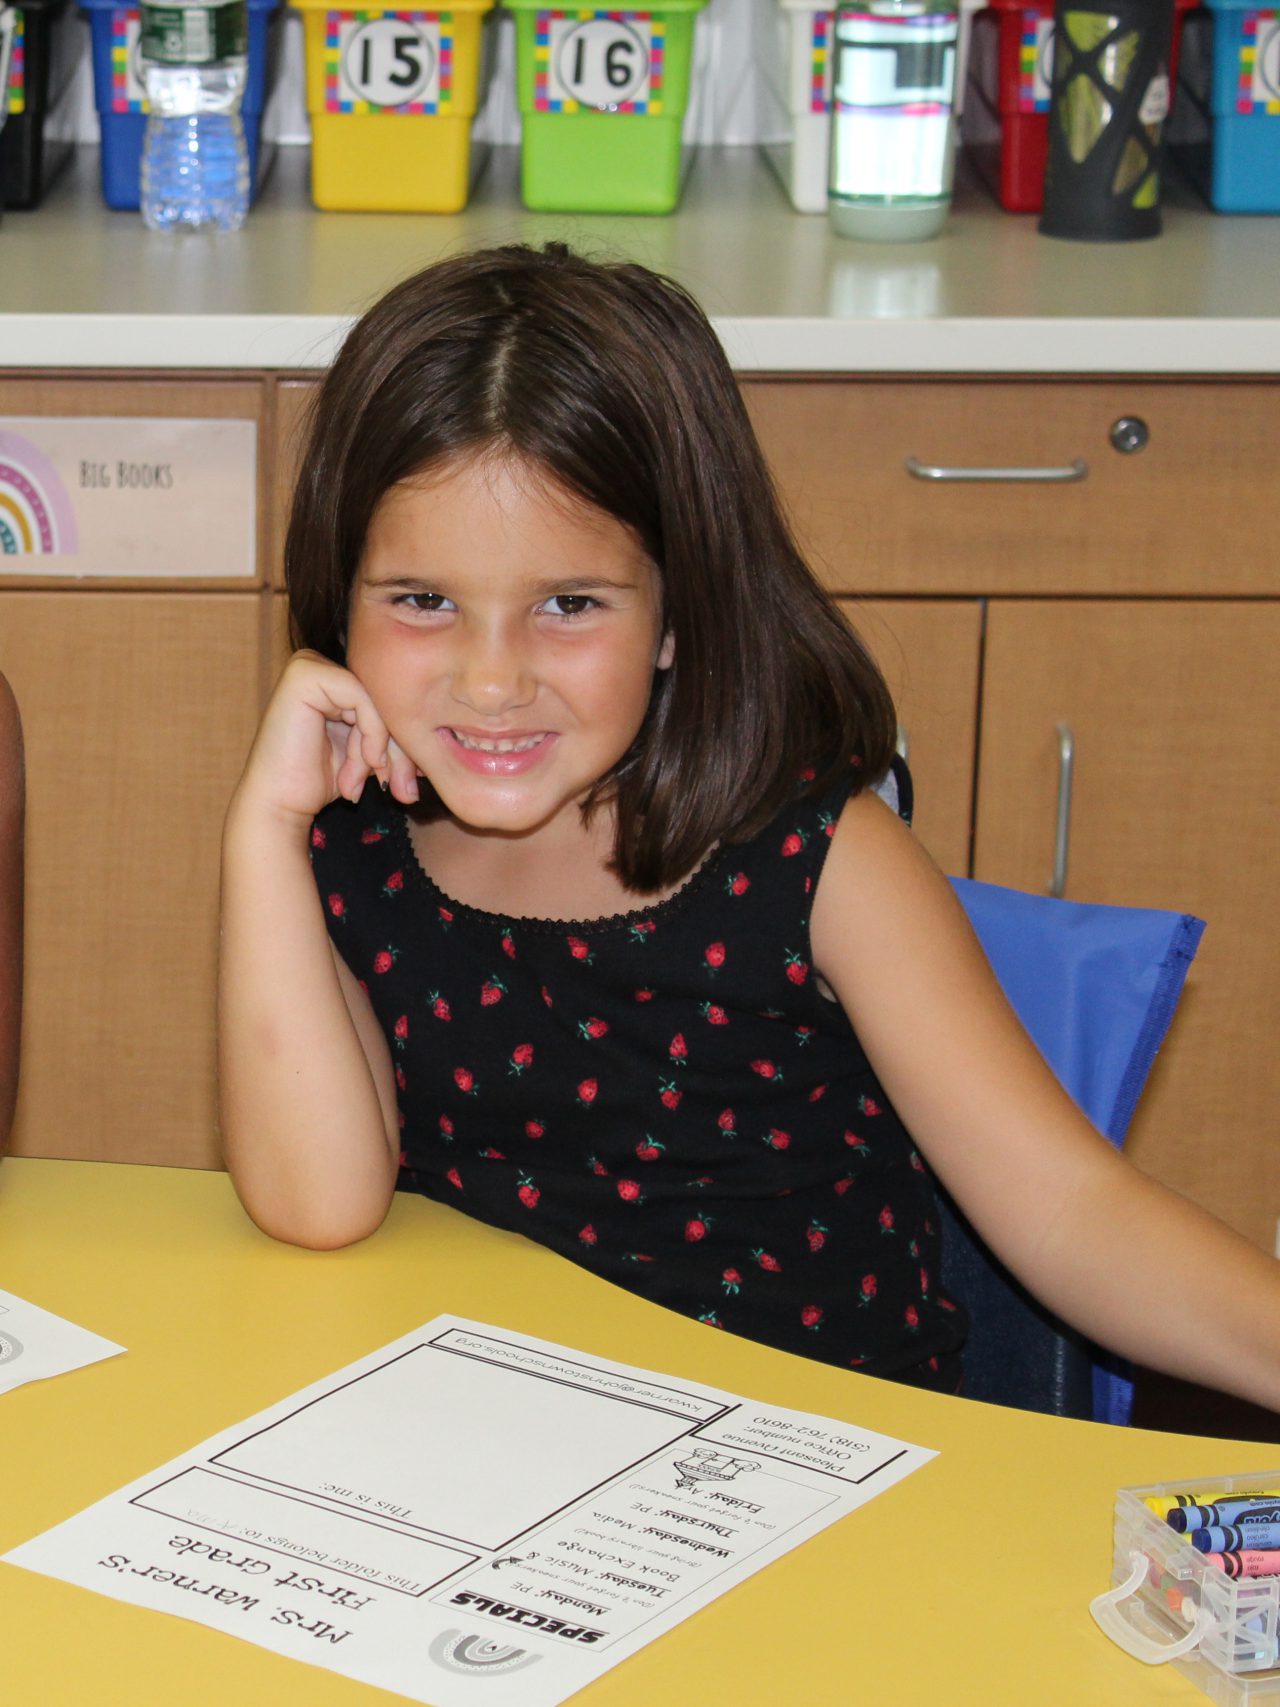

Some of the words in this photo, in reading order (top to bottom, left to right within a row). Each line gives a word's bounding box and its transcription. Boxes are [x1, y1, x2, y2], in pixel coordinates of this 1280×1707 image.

[360, 35, 422, 87] 15
[573, 35, 636, 87] 16
[743, 1426, 802, 1444] number:
[753, 1417, 828, 1440] 762-8610
[722, 1433, 778, 1452] Avenue
[803, 1441, 852, 1460] Office
[829, 1436, 872, 1453] (518)
[779, 1448, 846, 1473] Pleasant
[317, 1483, 354, 1500] me:
[356, 1494, 372, 1505] is
[377, 1500, 413, 1519] This
[630, 1501, 653, 1514] PE
[704, 1493, 763, 1514] Friday:
[592, 1511, 637, 1531] Media
[654, 1509, 733, 1539] Thursday:
[240, 1527, 263, 1540] to:
[637, 1527, 730, 1558] Wednesday:
[169, 1535, 272, 1574] Grade
[264, 1536, 328, 1562] belongs
[526, 1551, 541, 1560] &
[557, 1540, 637, 1569] Exchange
[327, 1557, 381, 1583] folder
[543, 1556, 594, 1576] Music
[639, 1565, 680, 1582] Book
[274, 1571, 375, 1610] First
[385, 1574, 420, 1592] This
[509, 1581, 533, 1594] PE
[594, 1573, 667, 1599] Tuesday:
[535, 1590, 608, 1617] Monday:
[270, 1608, 353, 1645] Mrs.
[450, 1592, 605, 1643] SPECIALS
